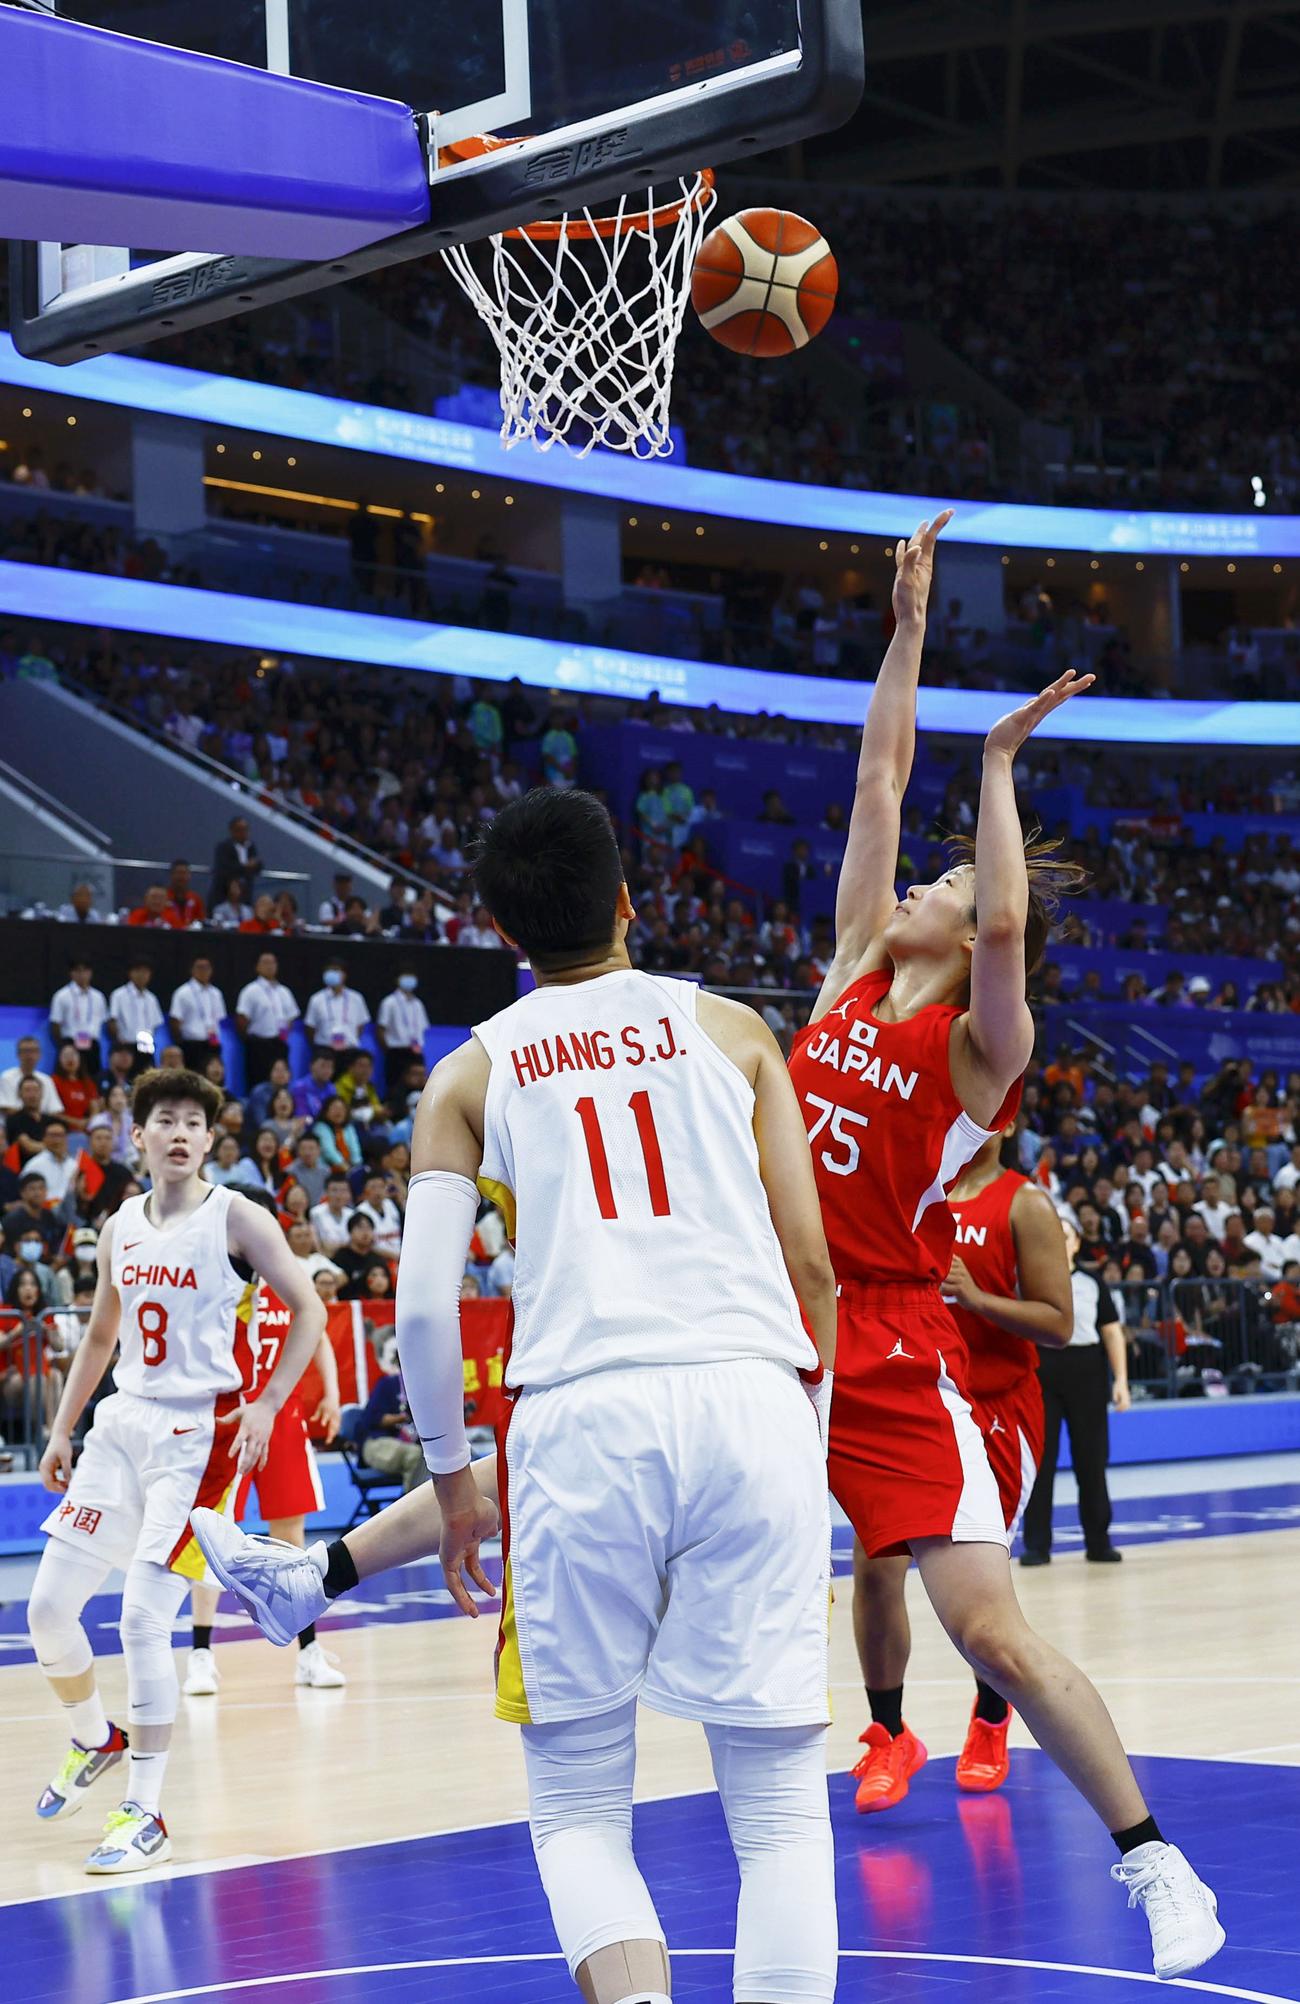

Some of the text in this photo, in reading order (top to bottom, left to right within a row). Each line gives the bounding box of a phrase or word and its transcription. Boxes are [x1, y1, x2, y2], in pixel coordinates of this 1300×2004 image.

[511, 1016, 687, 1088] HUANG S.J.
[806, 1031, 920, 1101] JAPAN
[574, 1090, 671, 1220] 11
[804, 1091, 869, 1176] 75
[121, 1264, 198, 1290] CHINA
[137, 1301, 169, 1367] 8
[257, 1310, 291, 1327] PAN
[256, 1337, 280, 1371] 7
[59, 1500, 102, 1535] 中国
